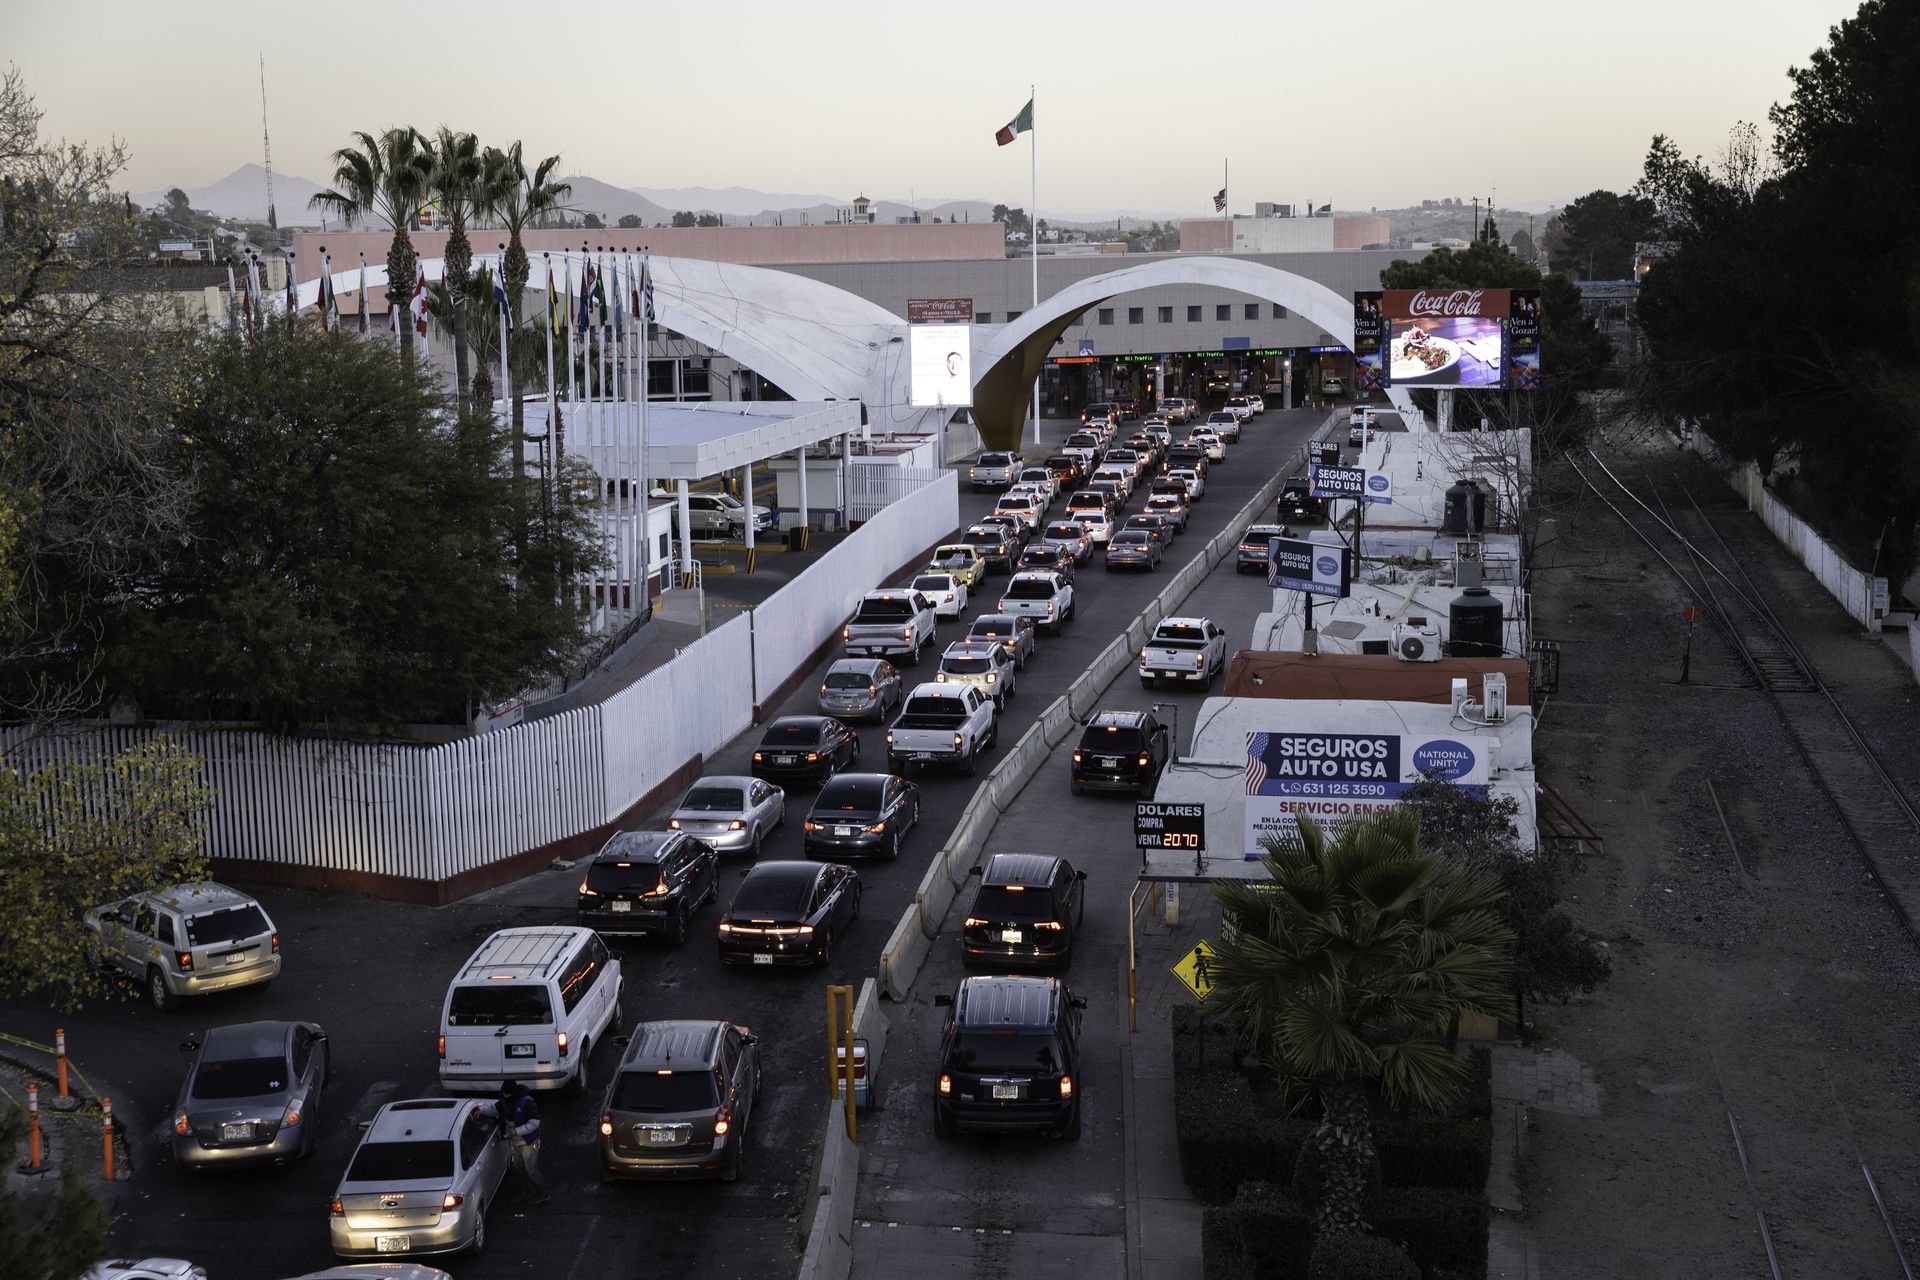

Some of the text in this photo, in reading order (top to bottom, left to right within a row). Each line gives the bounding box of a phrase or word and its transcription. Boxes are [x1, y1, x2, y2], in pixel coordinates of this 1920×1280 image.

[1409, 290, 1484, 316] Coca-Cola
[1355, 328, 1381, 336] Gozar!
[1511, 326, 1538, 335] Gozar!
[1310, 442, 1338, 451] DOLARES
[1318, 468, 1362, 482] SEGUROS
[1318, 479, 1362, 492] AUTO USA
[1280, 552, 1311, 563] SEGUROS
[1282, 560, 1310, 570] AUTO USA
[1280, 737, 1388, 759] SEGUROS
[1419, 750, 1469, 760] NATIONAL
[1279, 759, 1388, 778] AUTO USA
[1302, 783, 1386, 796] 631 125 3590
[1137, 804, 1202, 817] DOLARES
[1279, 801, 1350, 815] SERVICIO
[1353, 803, 1372, 815] EN
[1137, 817, 1164, 829] COMPRA
[1138, 833, 1198, 847] VENTA 20.70
